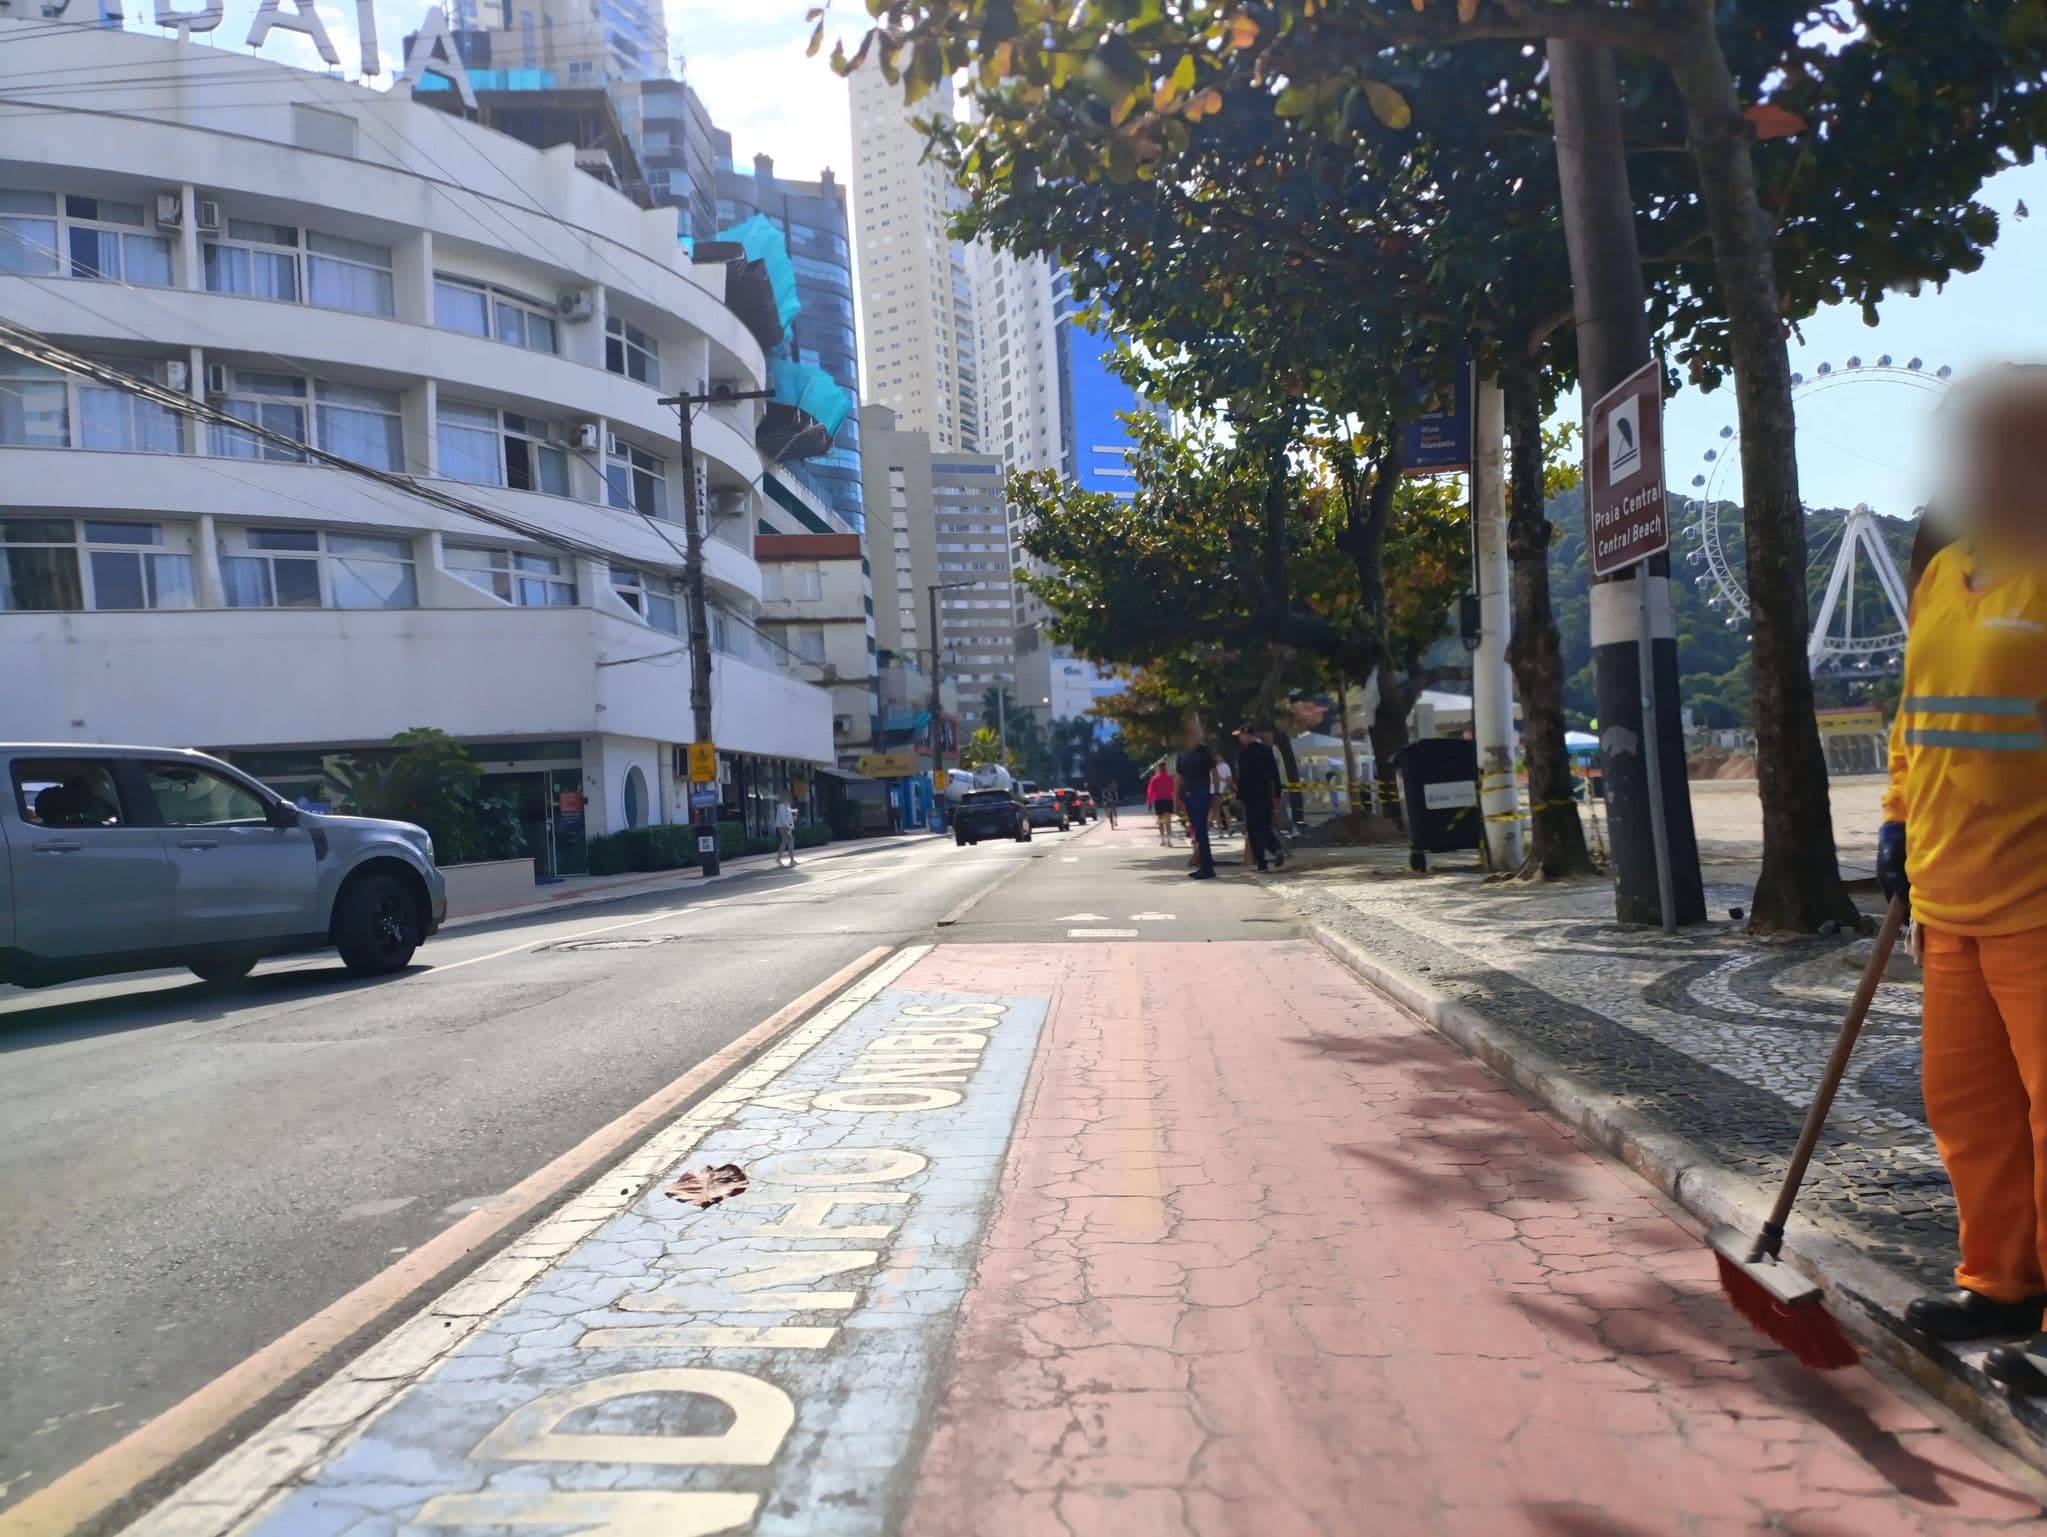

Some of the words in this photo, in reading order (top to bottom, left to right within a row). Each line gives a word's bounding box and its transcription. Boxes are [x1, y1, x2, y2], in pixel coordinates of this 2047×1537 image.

[1595, 505, 1620, 531] Praia
[1623, 479, 1662, 516] Central
[1598, 528, 1630, 557] Central
[1632, 514, 1661, 542] Beach
[744, 1002, 1009, 1112] ÔNIBUS
